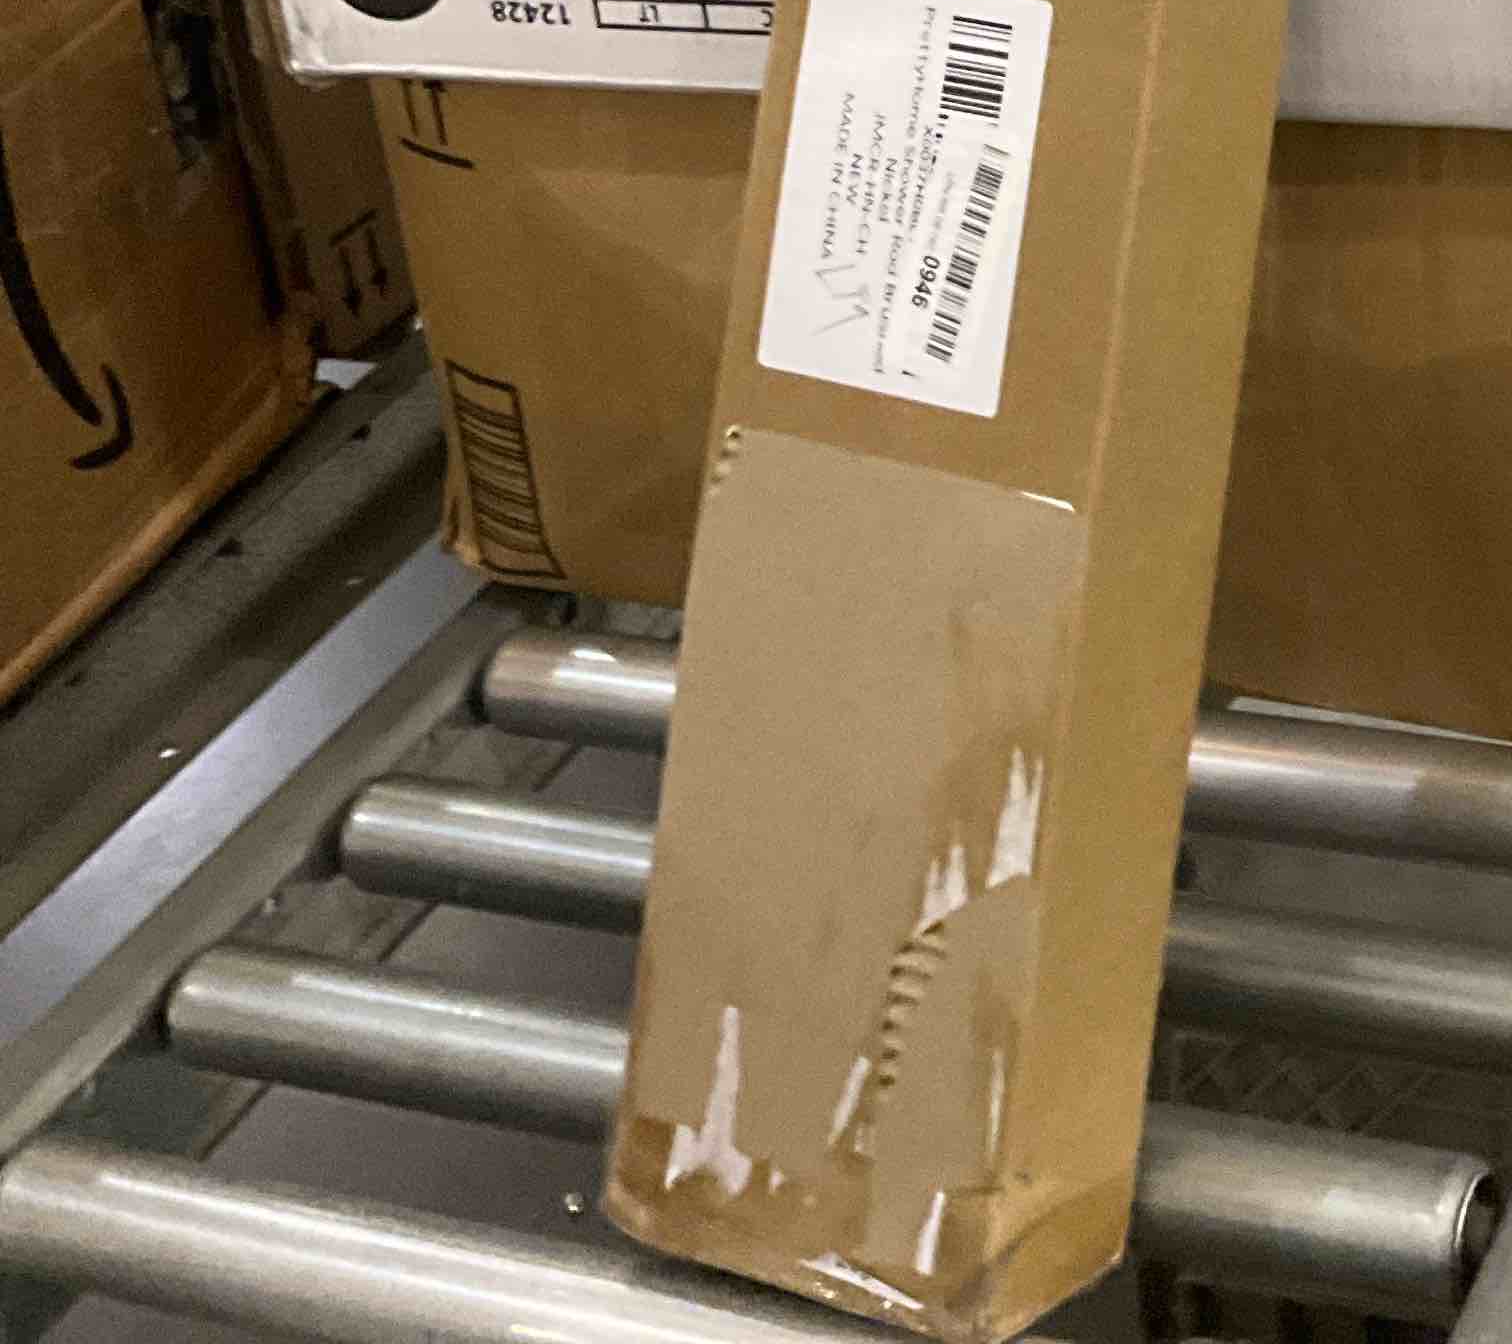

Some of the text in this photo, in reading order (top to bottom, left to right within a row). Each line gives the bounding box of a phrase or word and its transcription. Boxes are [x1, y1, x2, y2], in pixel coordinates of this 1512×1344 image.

[490, 0, 572, 25] 12428
[819, 91, 856, 261] MADE IN CHINA
[844, 152, 865, 206] NEW
[876, 156, 899, 224] Nickel
[892, 144, 918, 228] Shower
[886, 234, 904, 278] Rod
[909, 253, 942, 311] 0946
